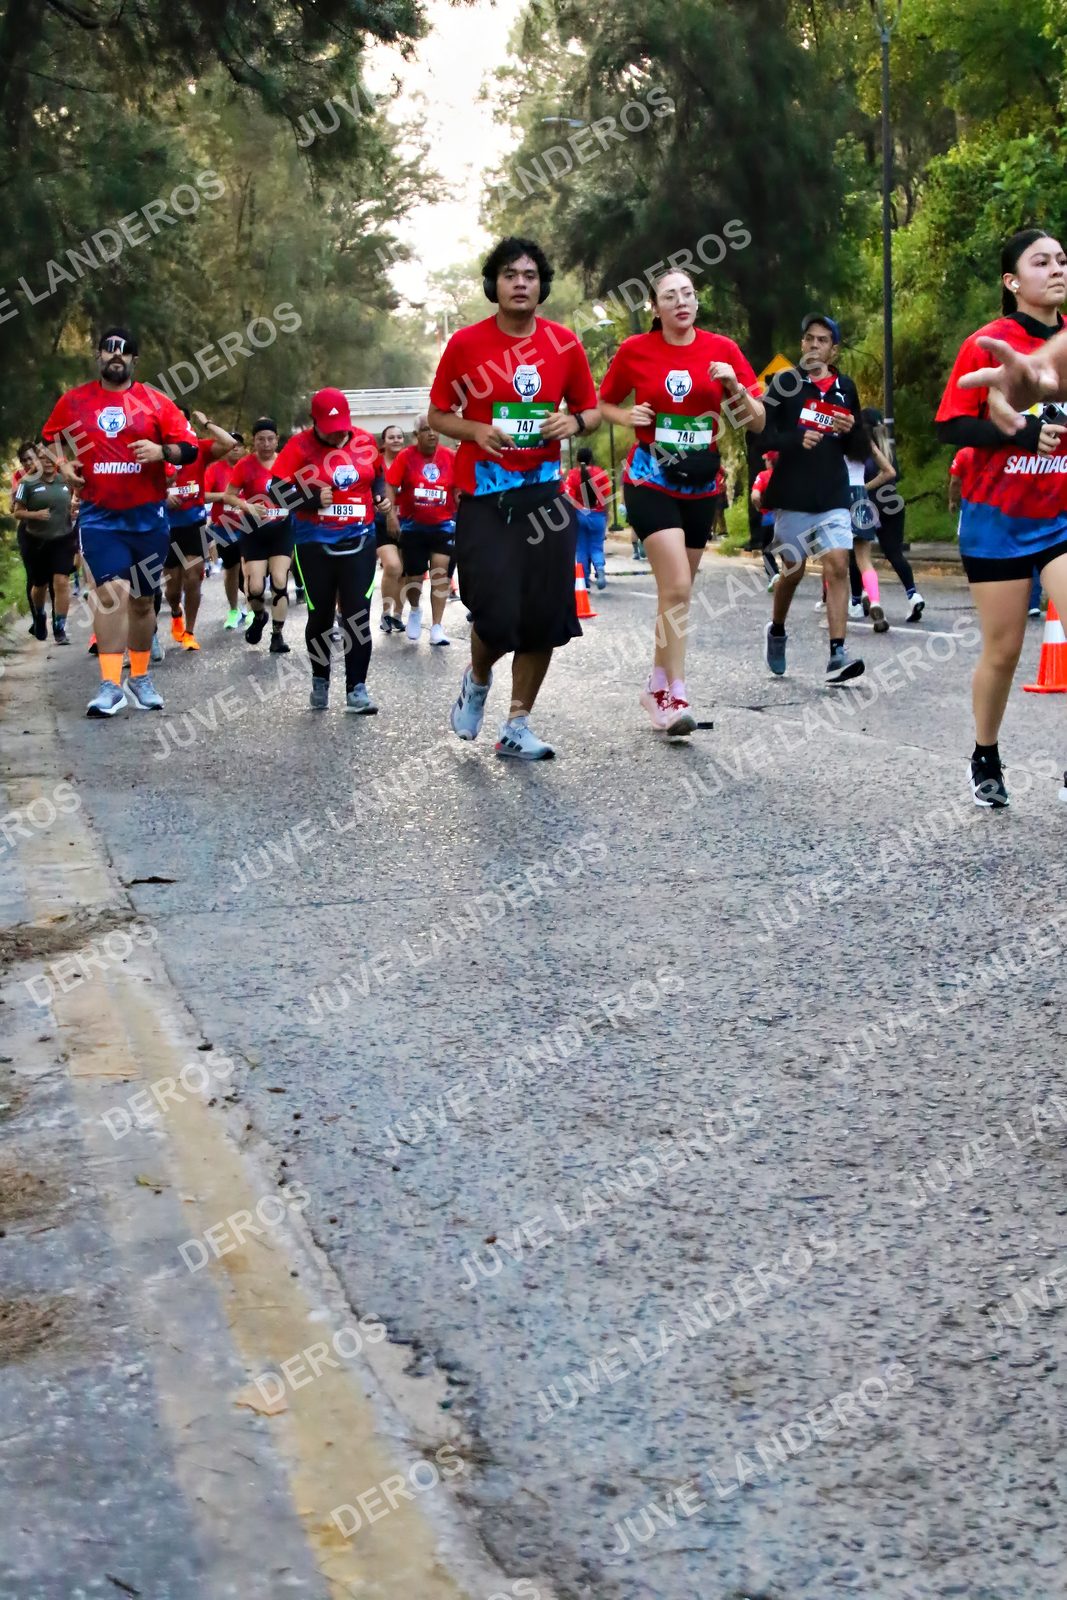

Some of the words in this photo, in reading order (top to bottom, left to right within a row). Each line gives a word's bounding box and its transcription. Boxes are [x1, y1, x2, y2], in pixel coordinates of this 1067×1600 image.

[517, 420, 534, 432] 747
[93, 462, 141, 474] SANTIAGO
[333, 504, 354, 516] 1839
